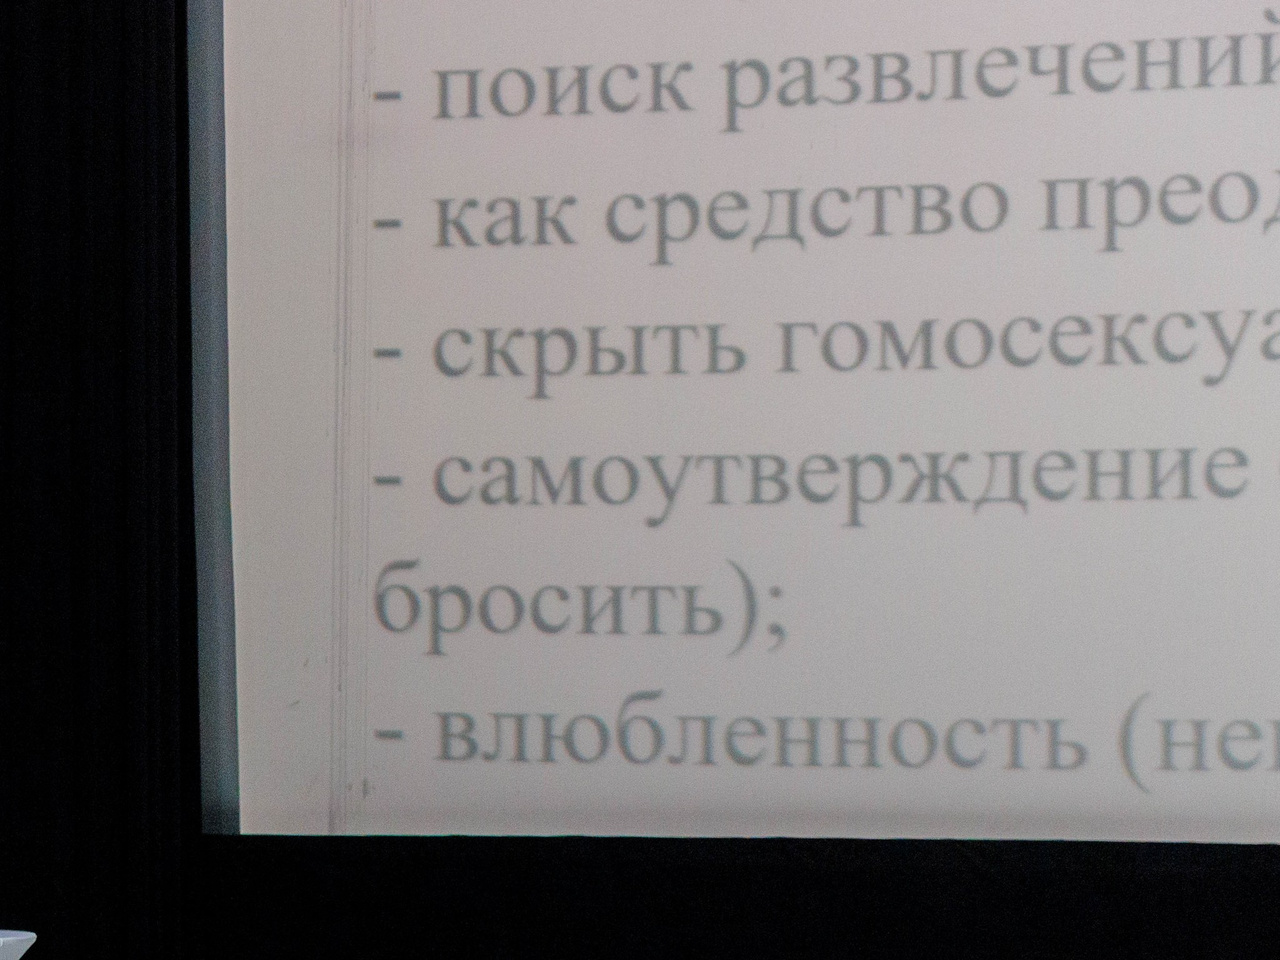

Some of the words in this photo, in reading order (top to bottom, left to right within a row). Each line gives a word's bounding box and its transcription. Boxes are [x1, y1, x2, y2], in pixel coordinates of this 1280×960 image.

[432, 60, 695, 121] поиск
[433, 194, 579, 249] как
[604, 181, 1011, 267] средство
[432, 323, 748, 401] скрыть
[432, 446, 1250, 530] самоутверждение
[373, 559, 787, 657] бросить);
[435, 689, 1089, 770] влюбленность
[1118, 691, 1280, 794] (не
